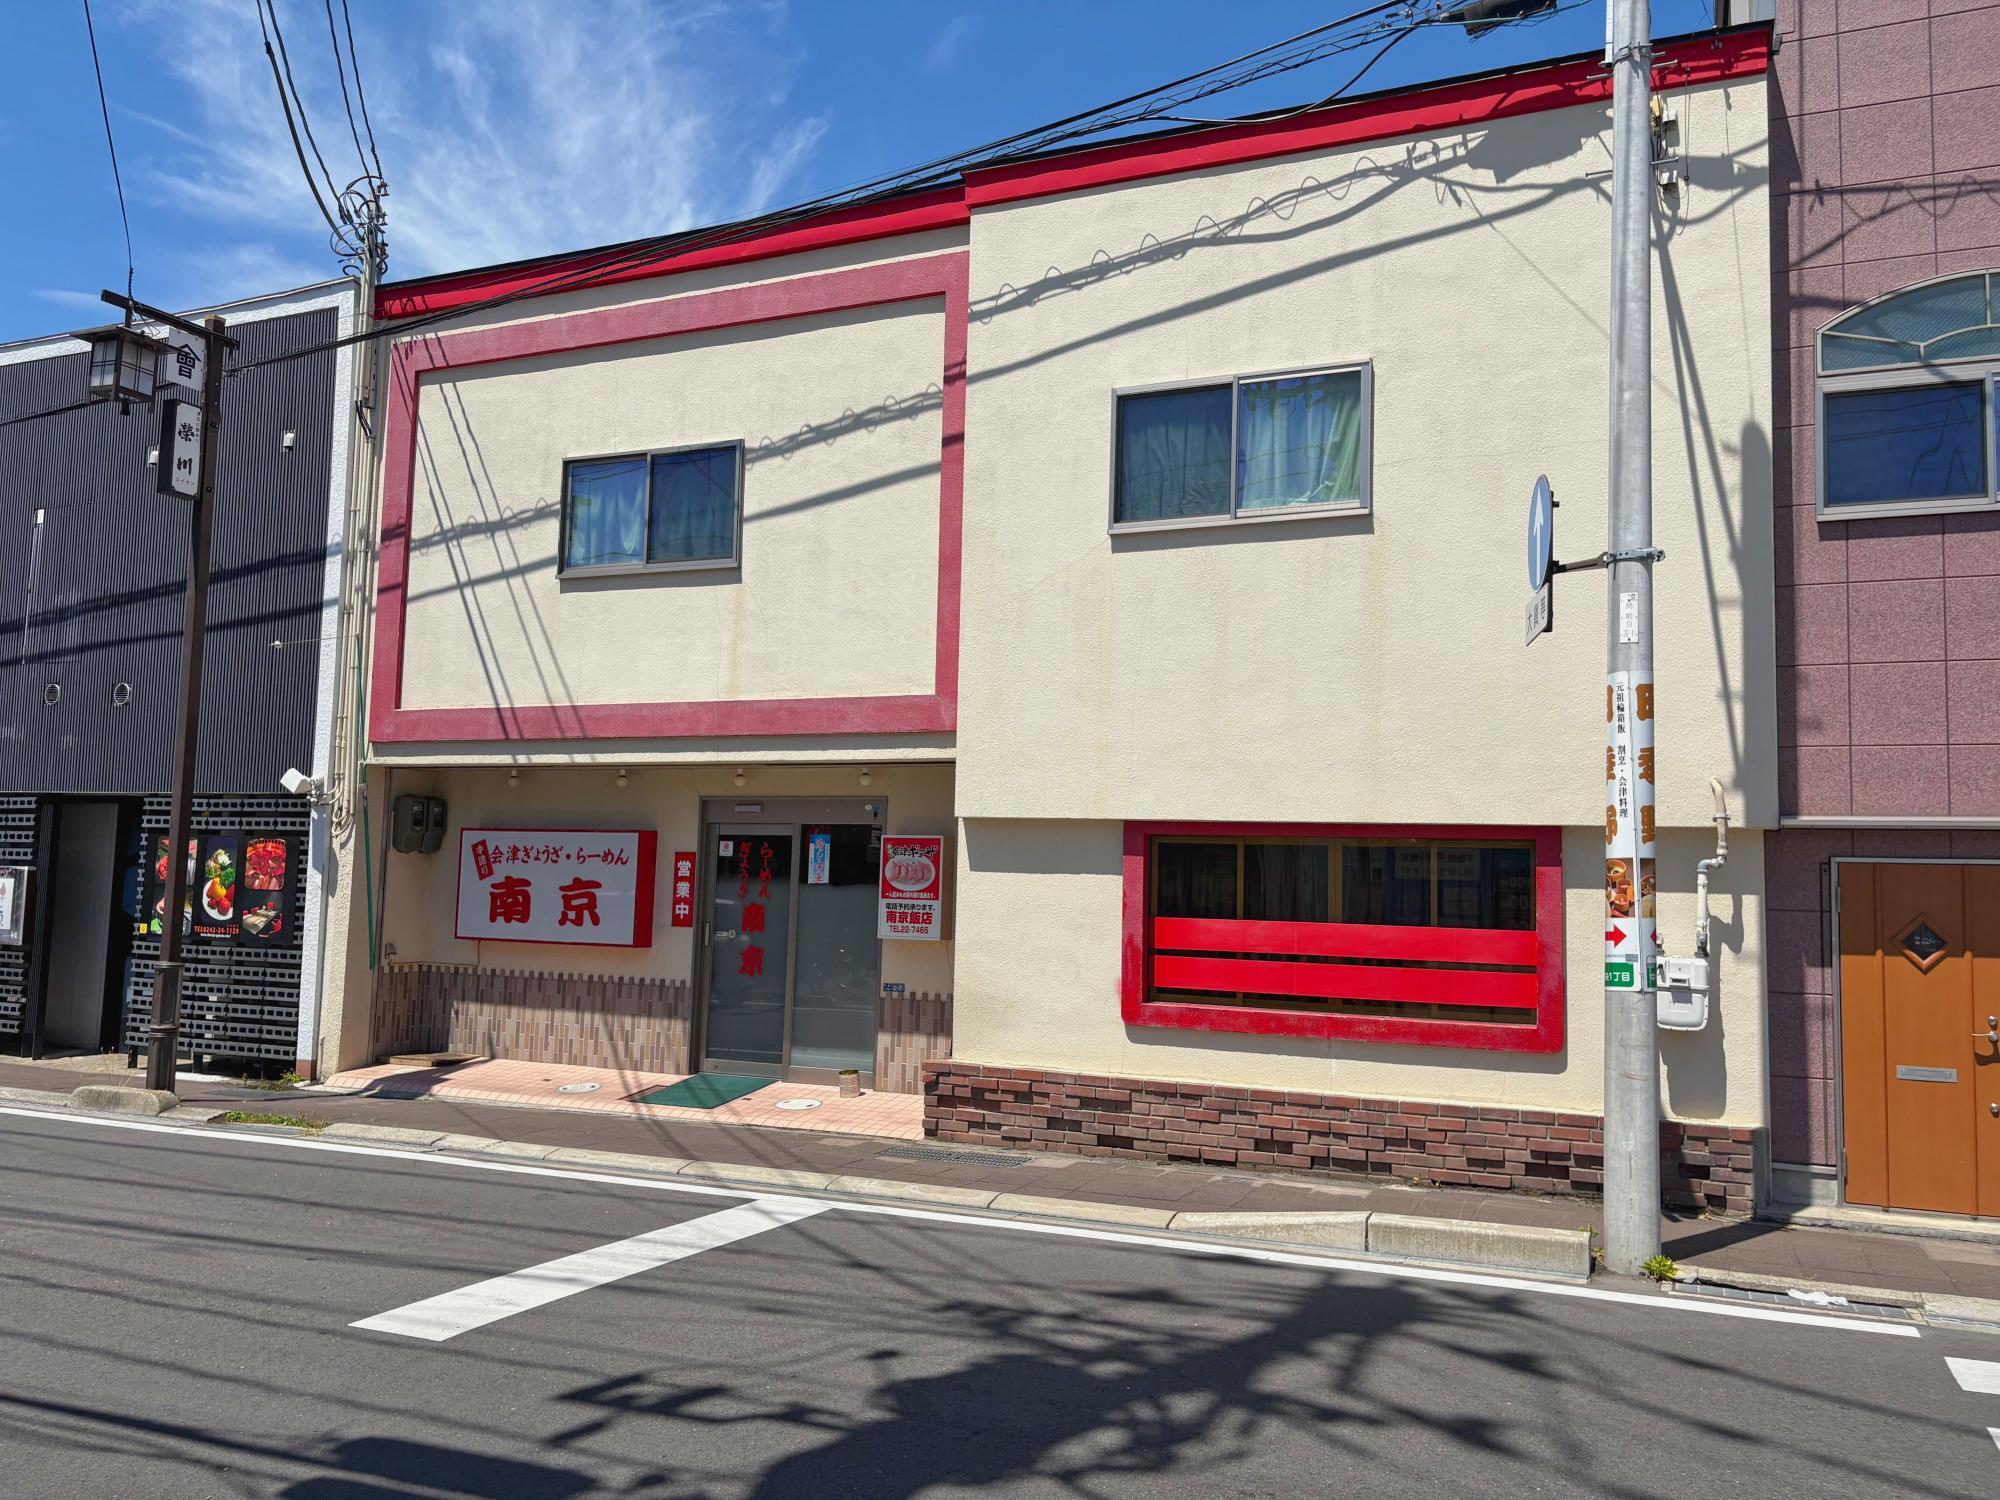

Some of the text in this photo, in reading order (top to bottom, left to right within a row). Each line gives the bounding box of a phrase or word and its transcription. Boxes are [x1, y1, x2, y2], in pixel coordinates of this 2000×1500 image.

[176, 343, 202, 380] 會
[1617, 745, 1628, 819] 割烹・会津料理
[490, 844, 630, 866] 会津ぎょうざ・らーめん
[758, 842, 774, 899] らーめん
[489, 876, 602, 927] 南京
[675, 860, 692, 918] 営業中
[885, 903, 935, 912] 電話予約承ります。
[739, 902, 765, 977] 南京
[886, 911, 933, 925] 南京飯店
